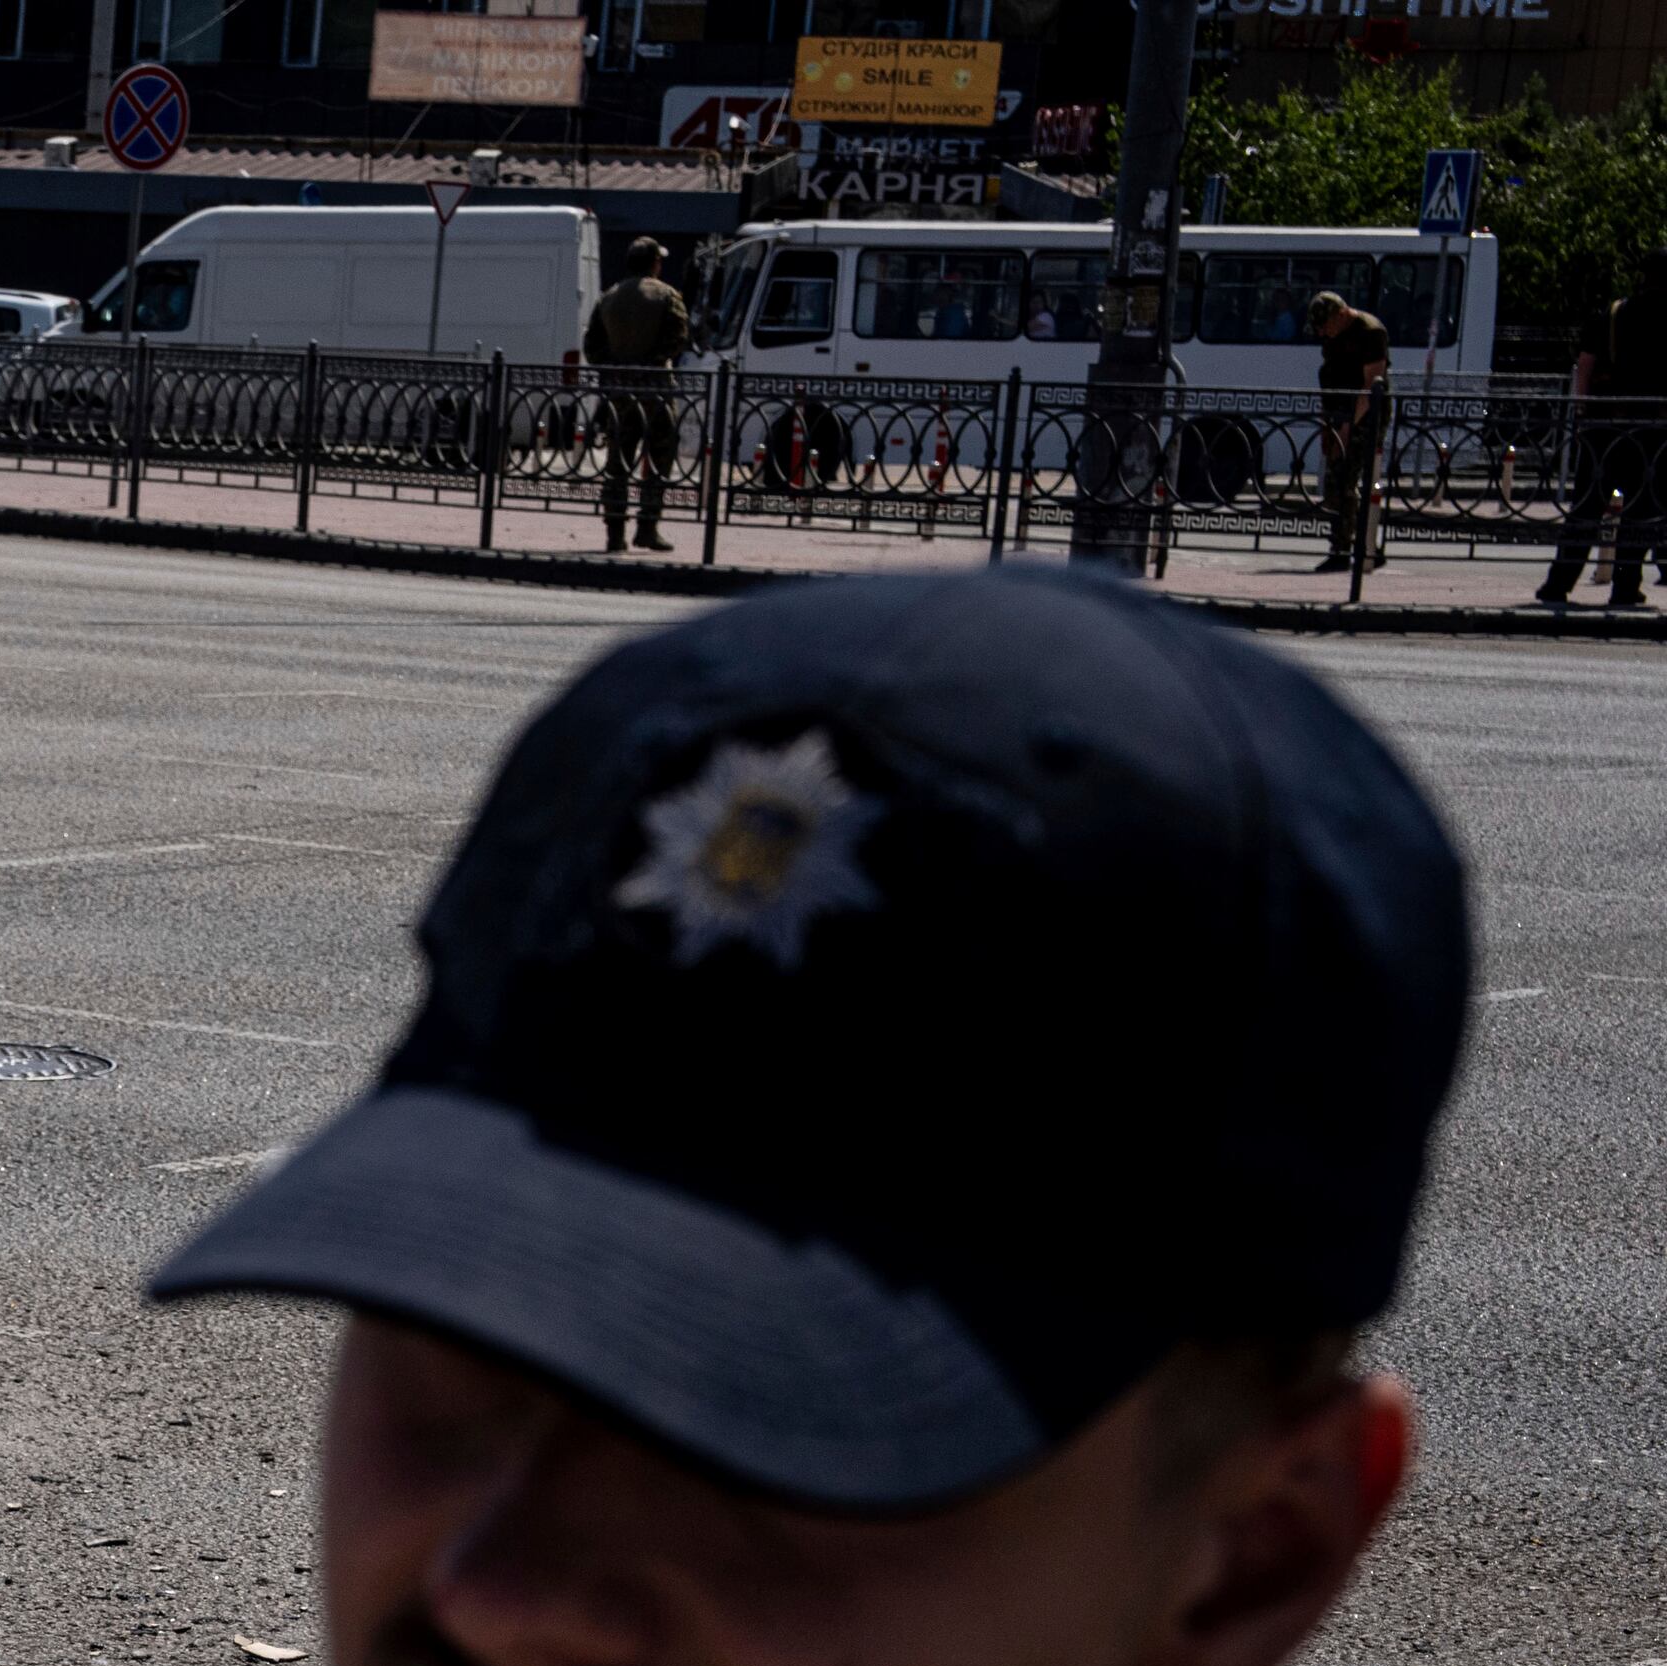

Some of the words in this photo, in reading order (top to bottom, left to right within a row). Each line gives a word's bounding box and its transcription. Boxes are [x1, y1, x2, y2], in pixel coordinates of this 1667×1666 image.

[822, 40, 900, 58] СТУДІЯ
[906, 42, 977, 60] КРАСИ
[862, 67, 933, 86] SMILE
